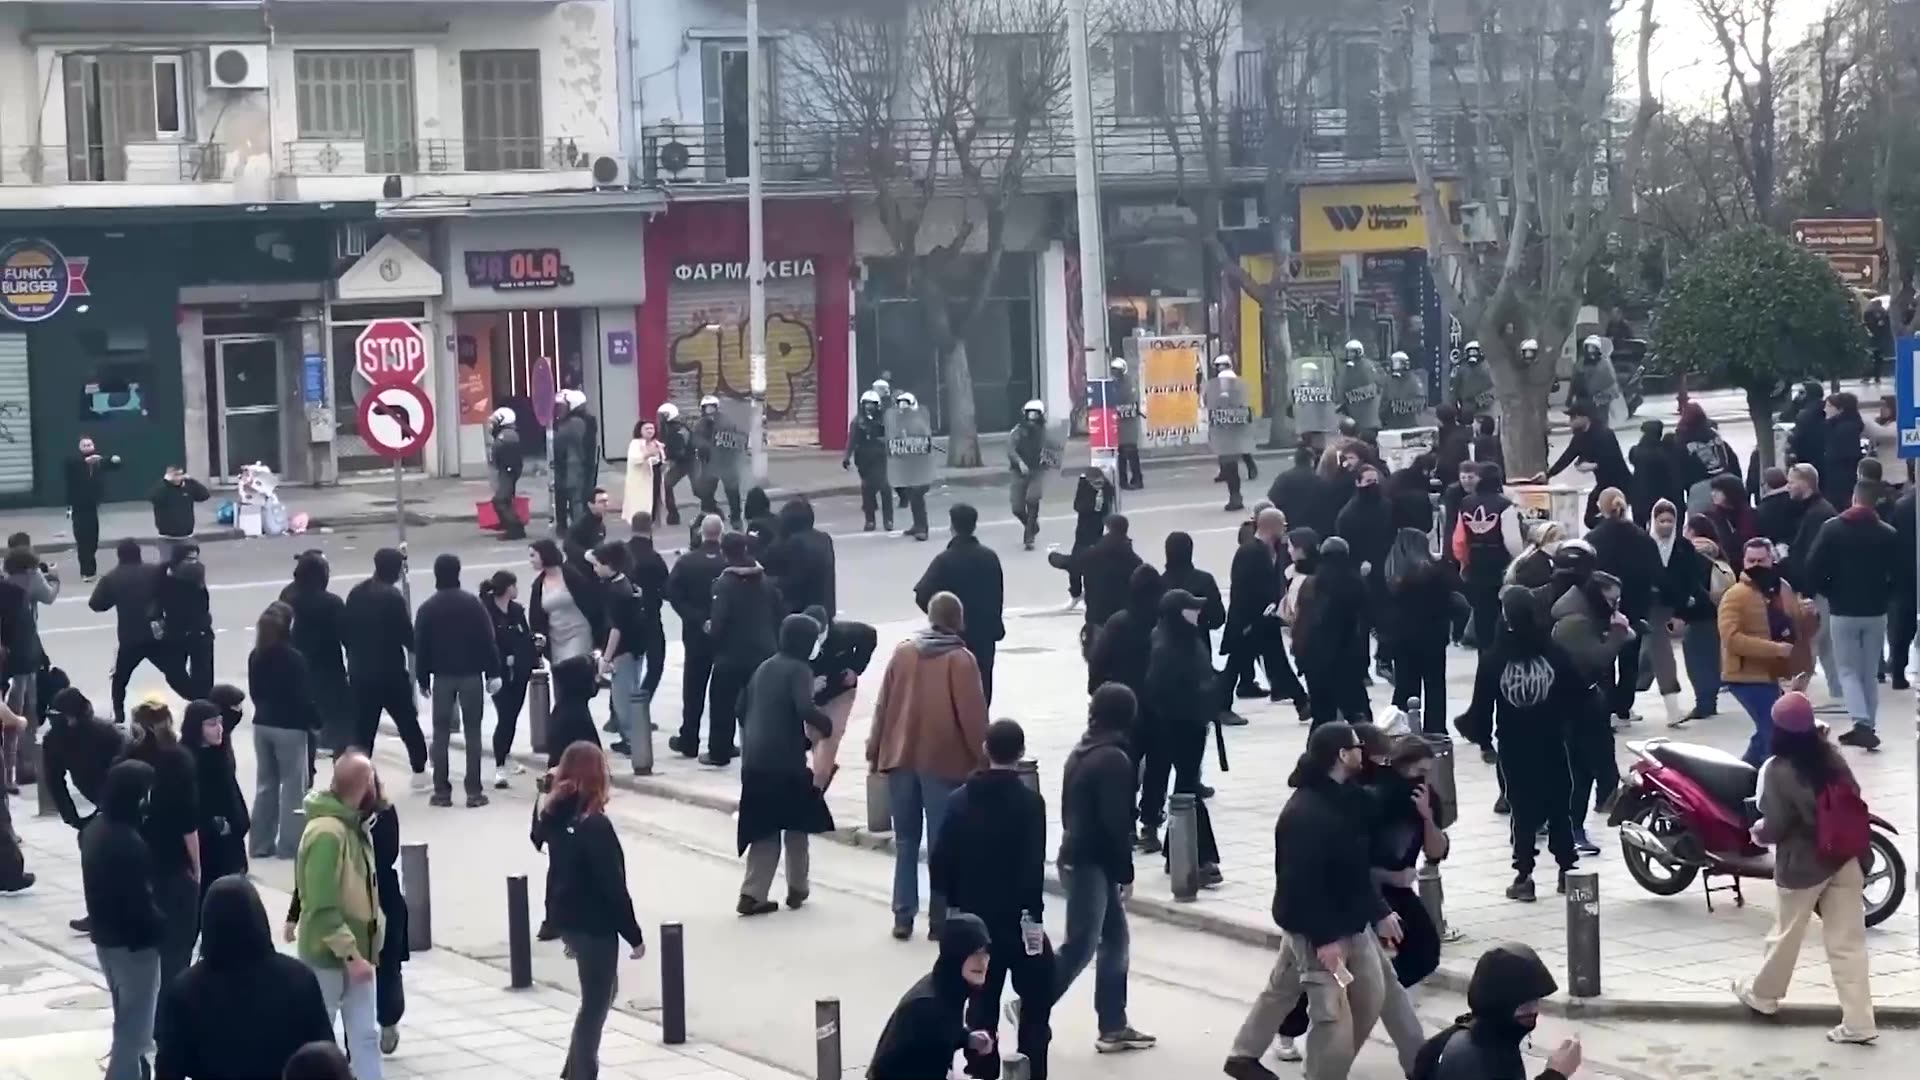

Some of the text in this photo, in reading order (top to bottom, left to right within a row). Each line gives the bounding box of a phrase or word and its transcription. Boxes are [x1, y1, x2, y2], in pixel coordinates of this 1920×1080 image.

[1367, 204, 1423, 216] Western
[1367, 216, 1408, 231] Union
[510, 253, 558, 279] OLA
[4, 267, 53, 280] FUNKY
[2, 280, 58, 294] BURGER
[362, 336, 422, 372] STOP
[1295, 394, 1334, 404] POLICE
[1213, 415, 1249, 425] POLICE
